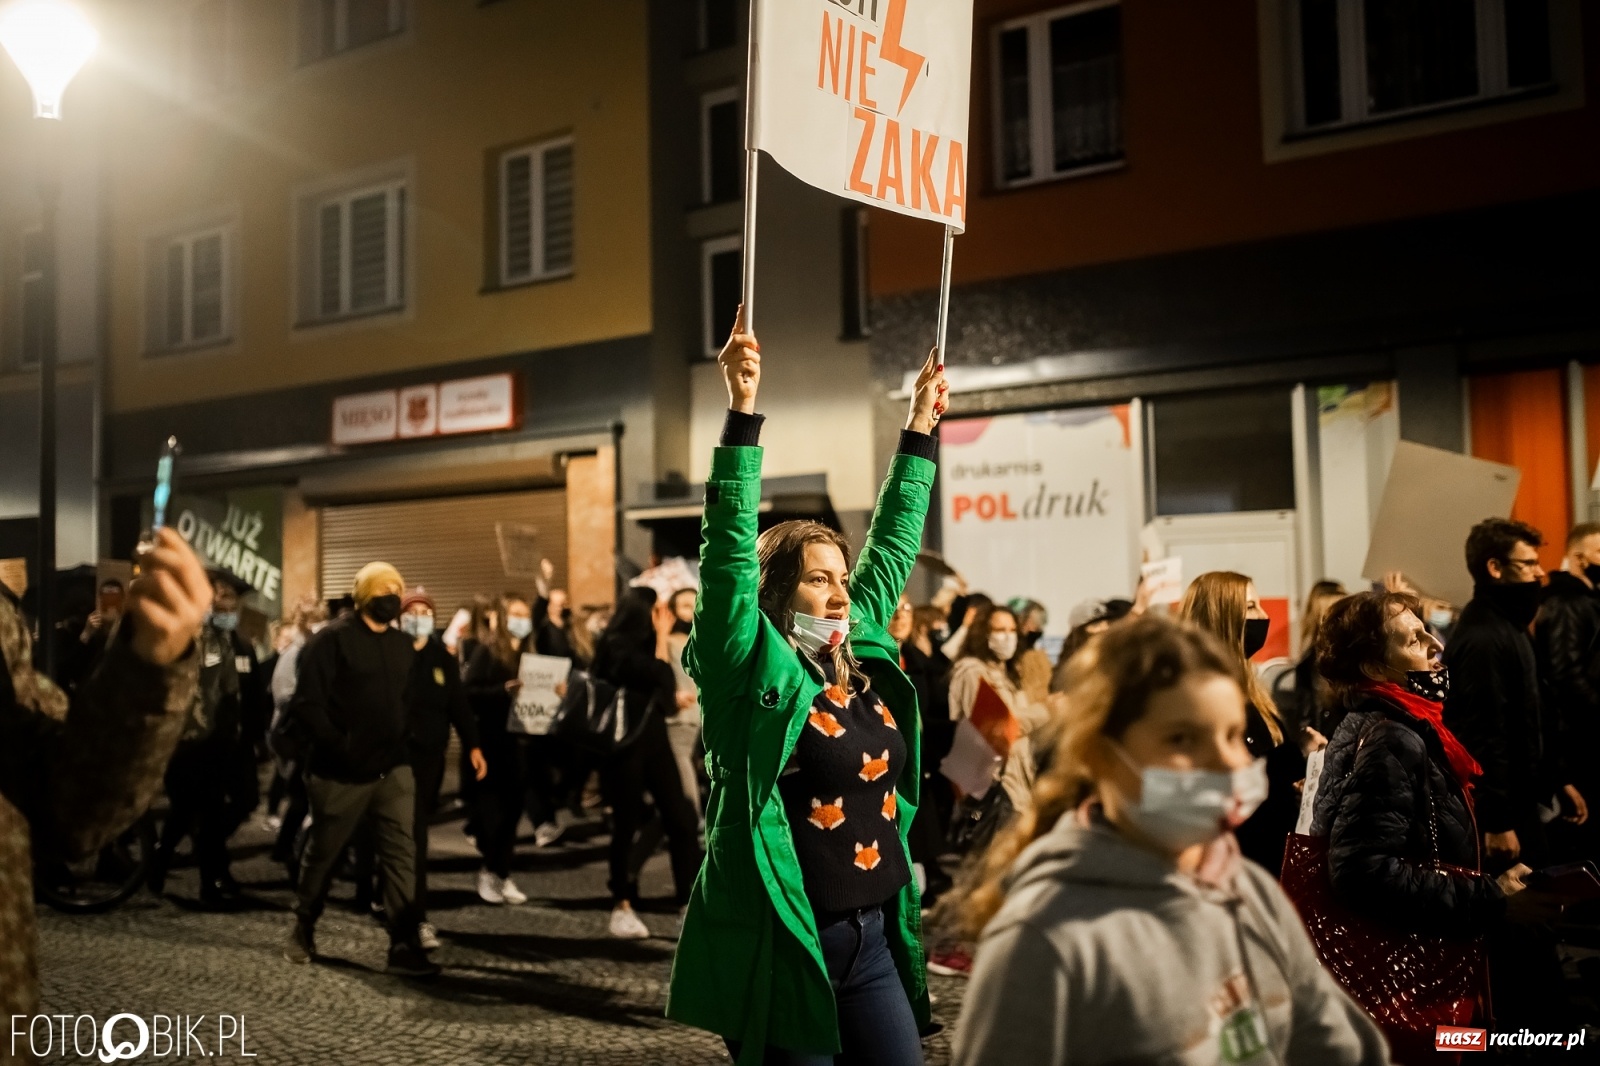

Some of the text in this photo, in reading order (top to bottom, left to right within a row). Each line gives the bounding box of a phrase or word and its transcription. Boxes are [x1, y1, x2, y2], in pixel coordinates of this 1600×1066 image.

[817, 9, 877, 109] NIE
[850, 106, 966, 224] ZAKA
[952, 460, 1043, 480] drukarnia
[177, 508, 281, 601] OTWARTE
[222, 502, 264, 551] JUŻ
